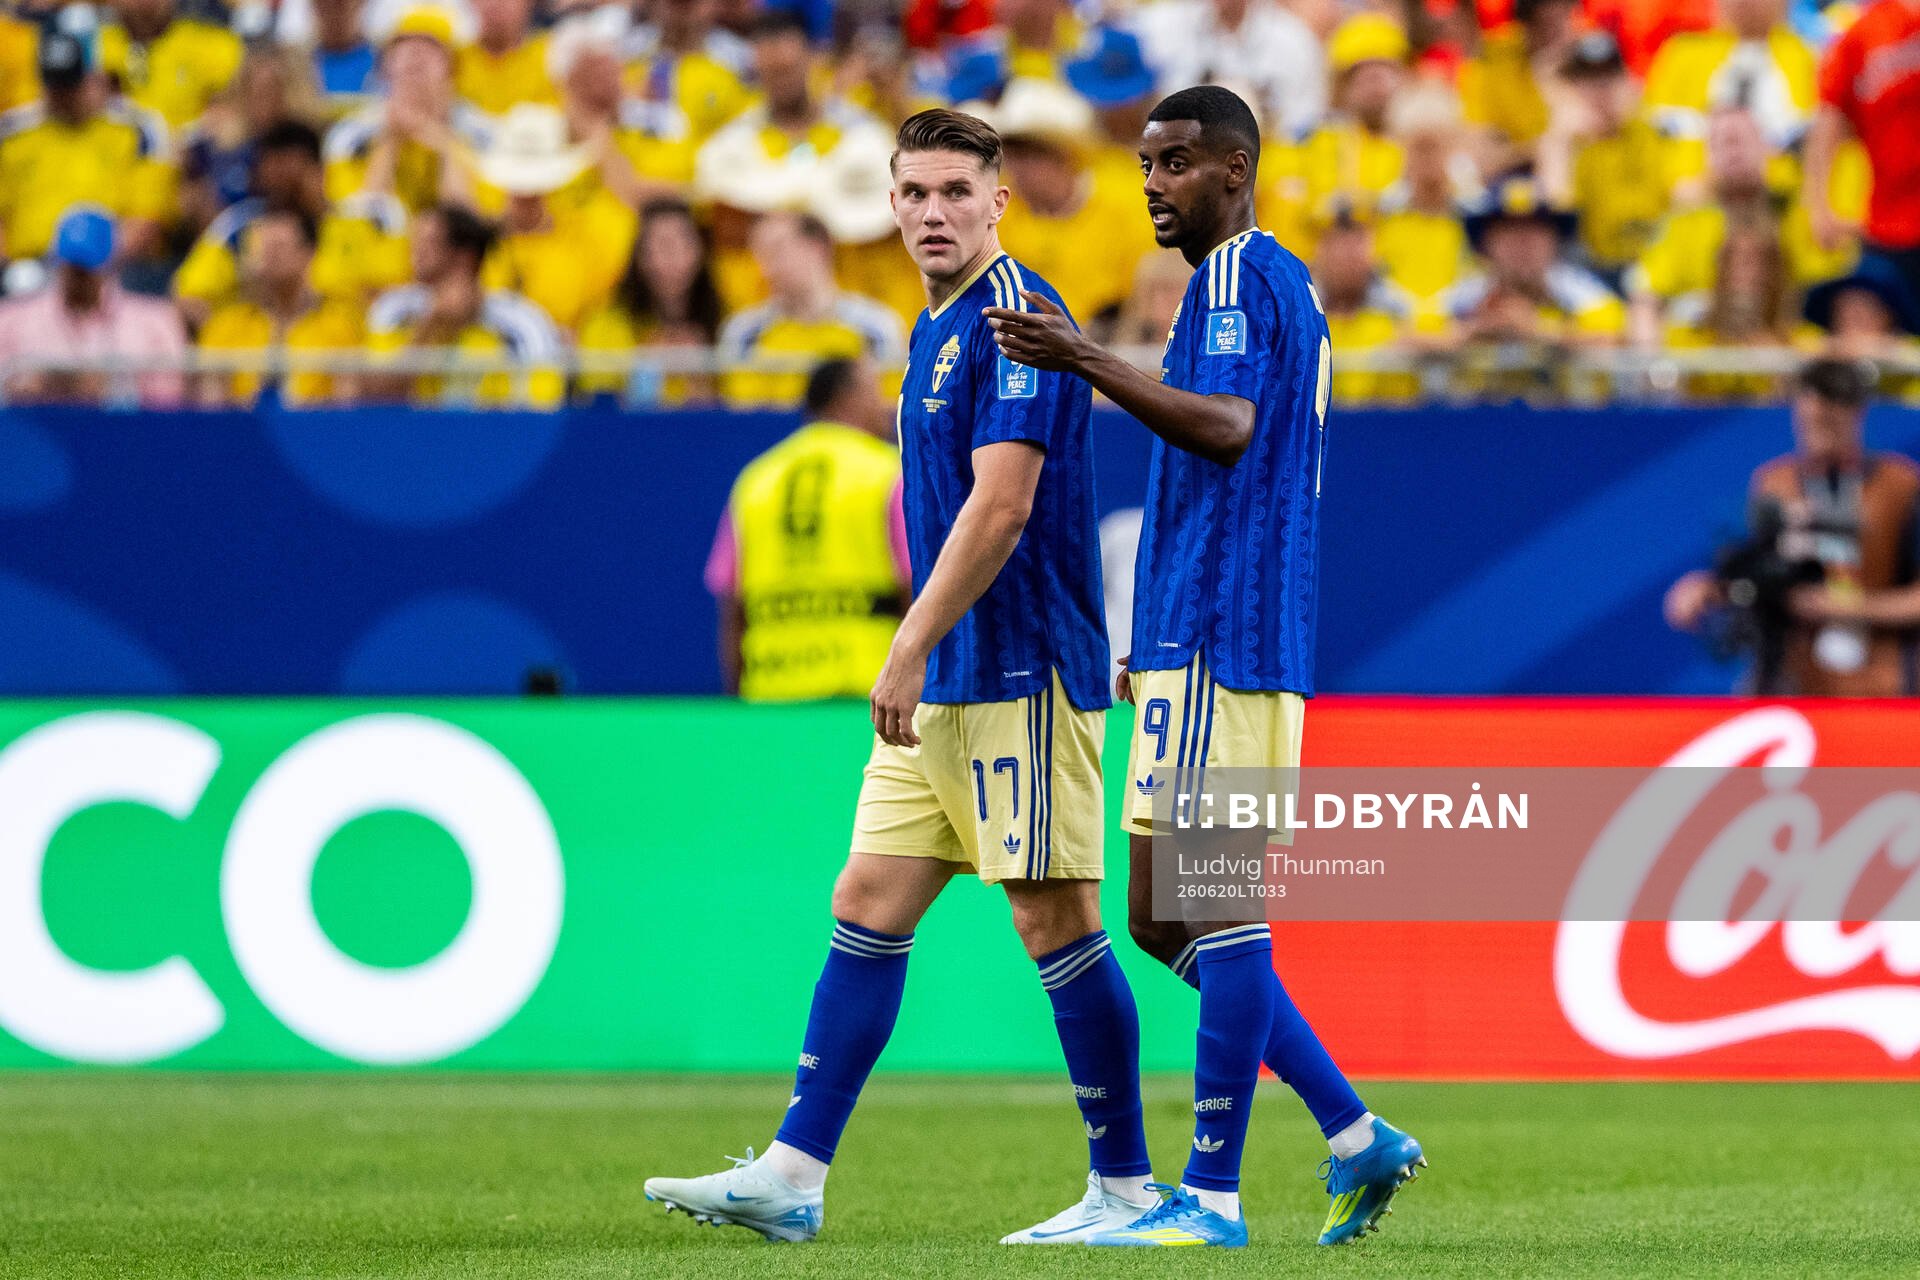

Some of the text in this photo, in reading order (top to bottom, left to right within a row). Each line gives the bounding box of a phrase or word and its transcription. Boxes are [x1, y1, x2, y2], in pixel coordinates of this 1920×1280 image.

[1217, 337, 1236, 346] PEACE
[1008, 380, 1026, 390] PEACE
[1143, 698, 1171, 762] 9
[973, 757, 1019, 823] 17
